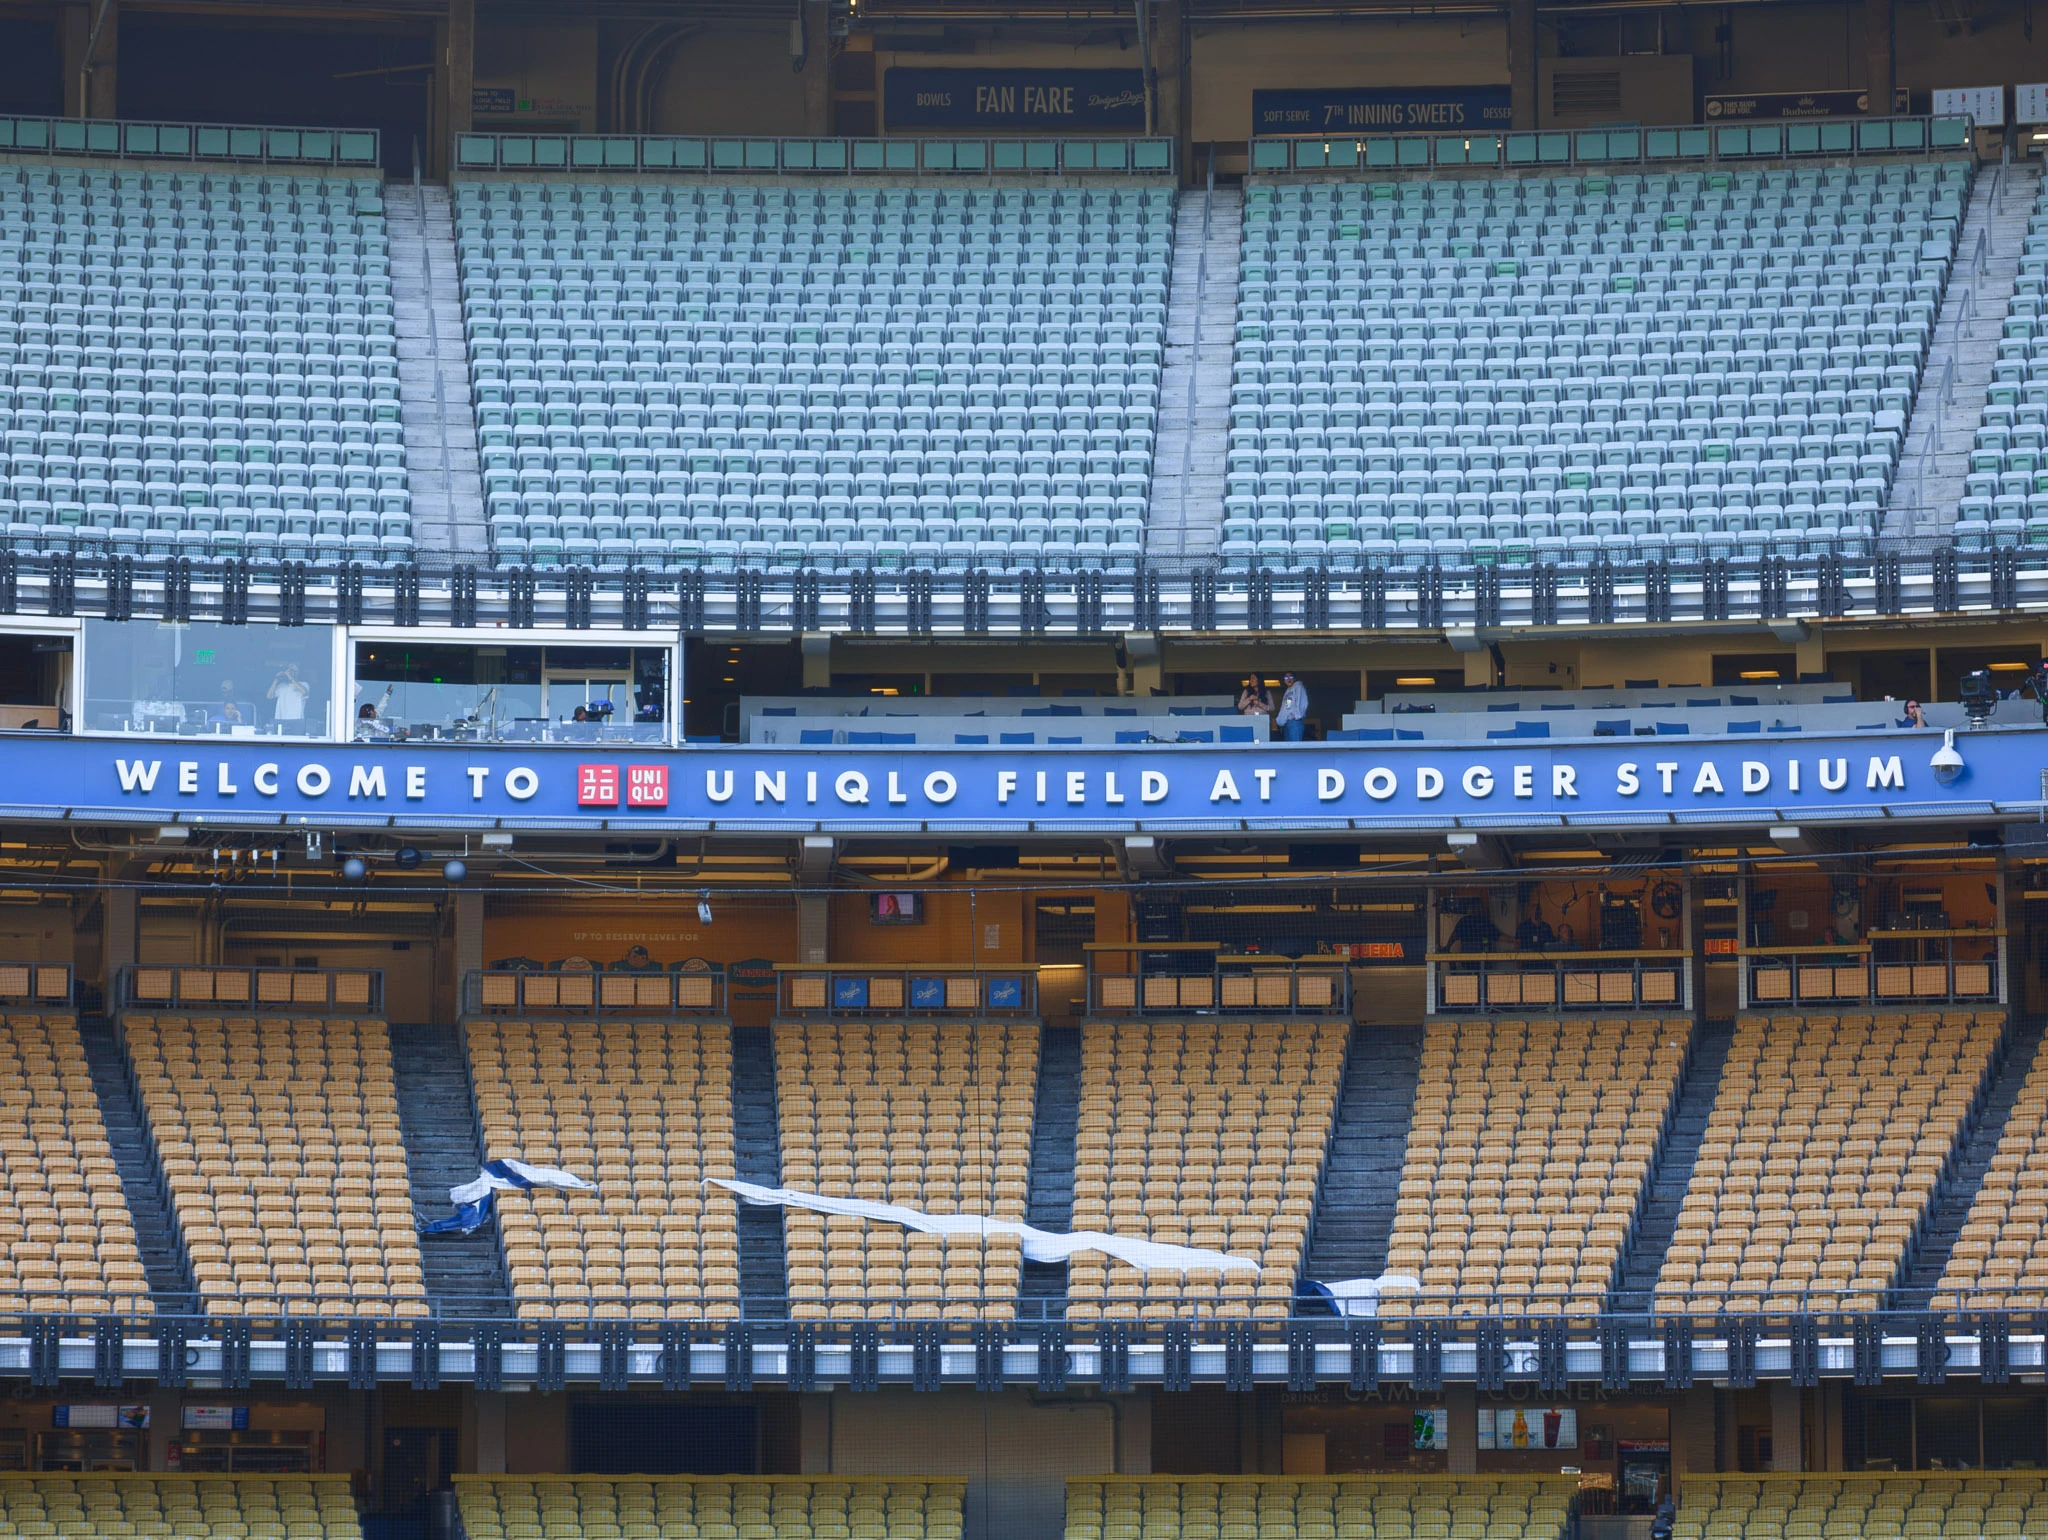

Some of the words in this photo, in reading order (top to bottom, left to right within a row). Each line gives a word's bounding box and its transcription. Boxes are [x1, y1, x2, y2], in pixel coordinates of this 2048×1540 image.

[917, 92, 951, 106] BOWLS
[976, 87, 1014, 113] FAN
[1024, 87, 1074, 114] FARE
[1263, 111, 1284, 122] SOFT
[1285, 110, 1310, 121] SERVE
[1348, 104, 1403, 125] INNING
[1408, 103, 1464, 123] SWEETS
[1782, 106, 1830, 117] Budweiser
[117, 759, 426, 797] WELCOME
[468, 767, 539, 799] TO
[632, 769, 661, 784] UNI
[707, 770, 957, 803] UNIQLO
[999, 771, 1169, 802] FIELD
[1210, 769, 1276, 800] AT
[1319, 766, 1578, 799] DODGER
[1617, 757, 1904, 795] STADIUM
[632, 786, 664, 802] QLO
[573, 932, 586, 940] UP
[590, 932, 602, 940] TO
[679, 933, 699, 941] FOR
[1333, 942, 1405, 958] TQUERIA
